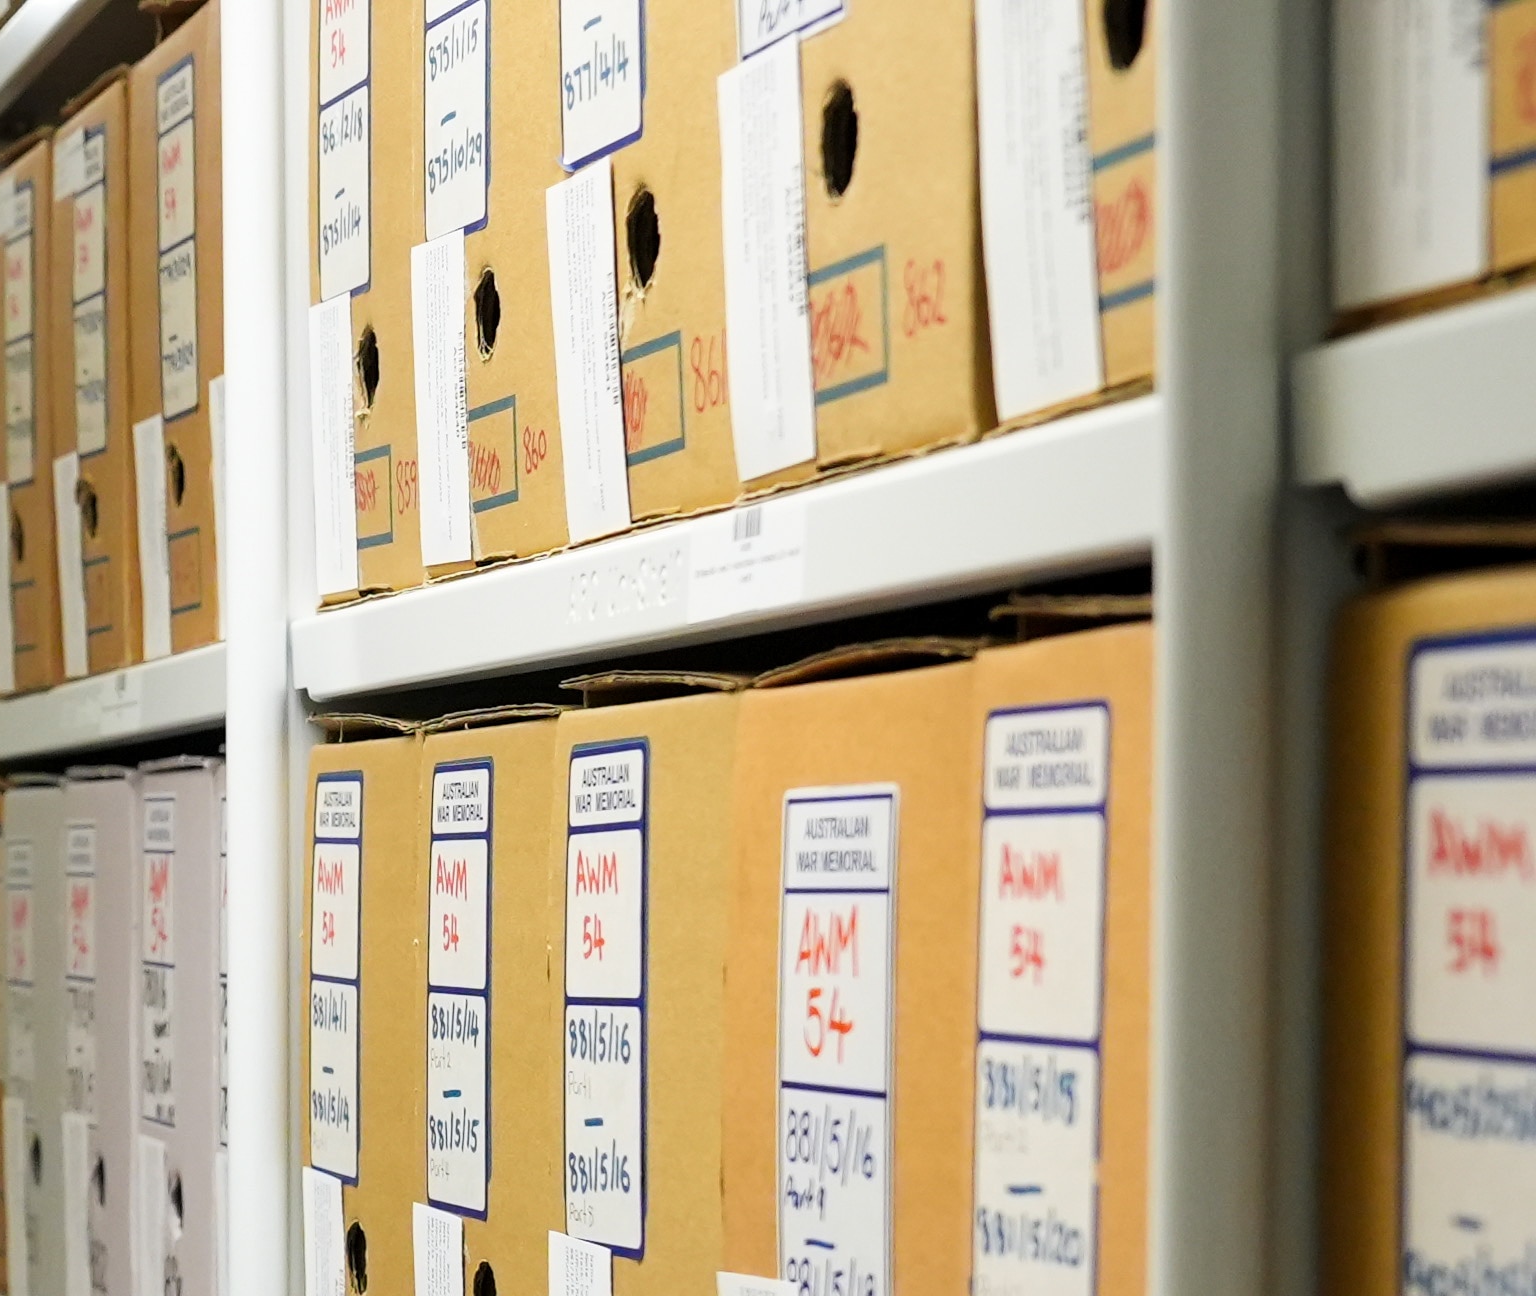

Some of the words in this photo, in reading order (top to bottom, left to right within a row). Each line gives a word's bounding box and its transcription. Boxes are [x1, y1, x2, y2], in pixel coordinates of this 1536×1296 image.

[330, 33, 346, 69] 54
[428, 17, 479, 82] 875/1/15
[564, 42, 630, 111] 877/4/4
[428, 132, 482, 197] 875/10/29
[524, 426, 548, 476] 860
[441, 780, 479, 803] AUSTRALIAN
[581, 764, 630, 789] AUSTRALIAN
[437, 804, 451, 825] WAR
[452, 802, 484, 824] MEMORIAL
[574, 794, 593, 814] WAR
[595, 790, 637, 812] MEMORIAL
[804, 816, 870, 841] AUSTRALIAN
[317, 854, 344, 896] AWM
[435, 853, 468, 901] AWM
[576, 850, 619, 898] AWM
[795, 849, 819, 873] WAR
[821, 847, 877, 873] MEMORIAL
[997, 842, 1065, 902] AWM
[321, 911, 335, 948] 54
[442, 911, 459, 954] 54
[583, 914, 605, 962] 54
[795, 905, 860, 977] AWM
[1009, 925, 1046, 987] 54
[312, 992, 348, 1035] 881/4/1
[431, 998, 480, 1049] 881/5/14
[569, 1008, 631, 1066] 881/5/16
[803, 986, 853, 1063] 54
[429, 1106, 480, 1154] 881/5/15
[786, 1103, 876, 1186] 881/5/16
[568, 1138, 631, 1194] 881/5/16
